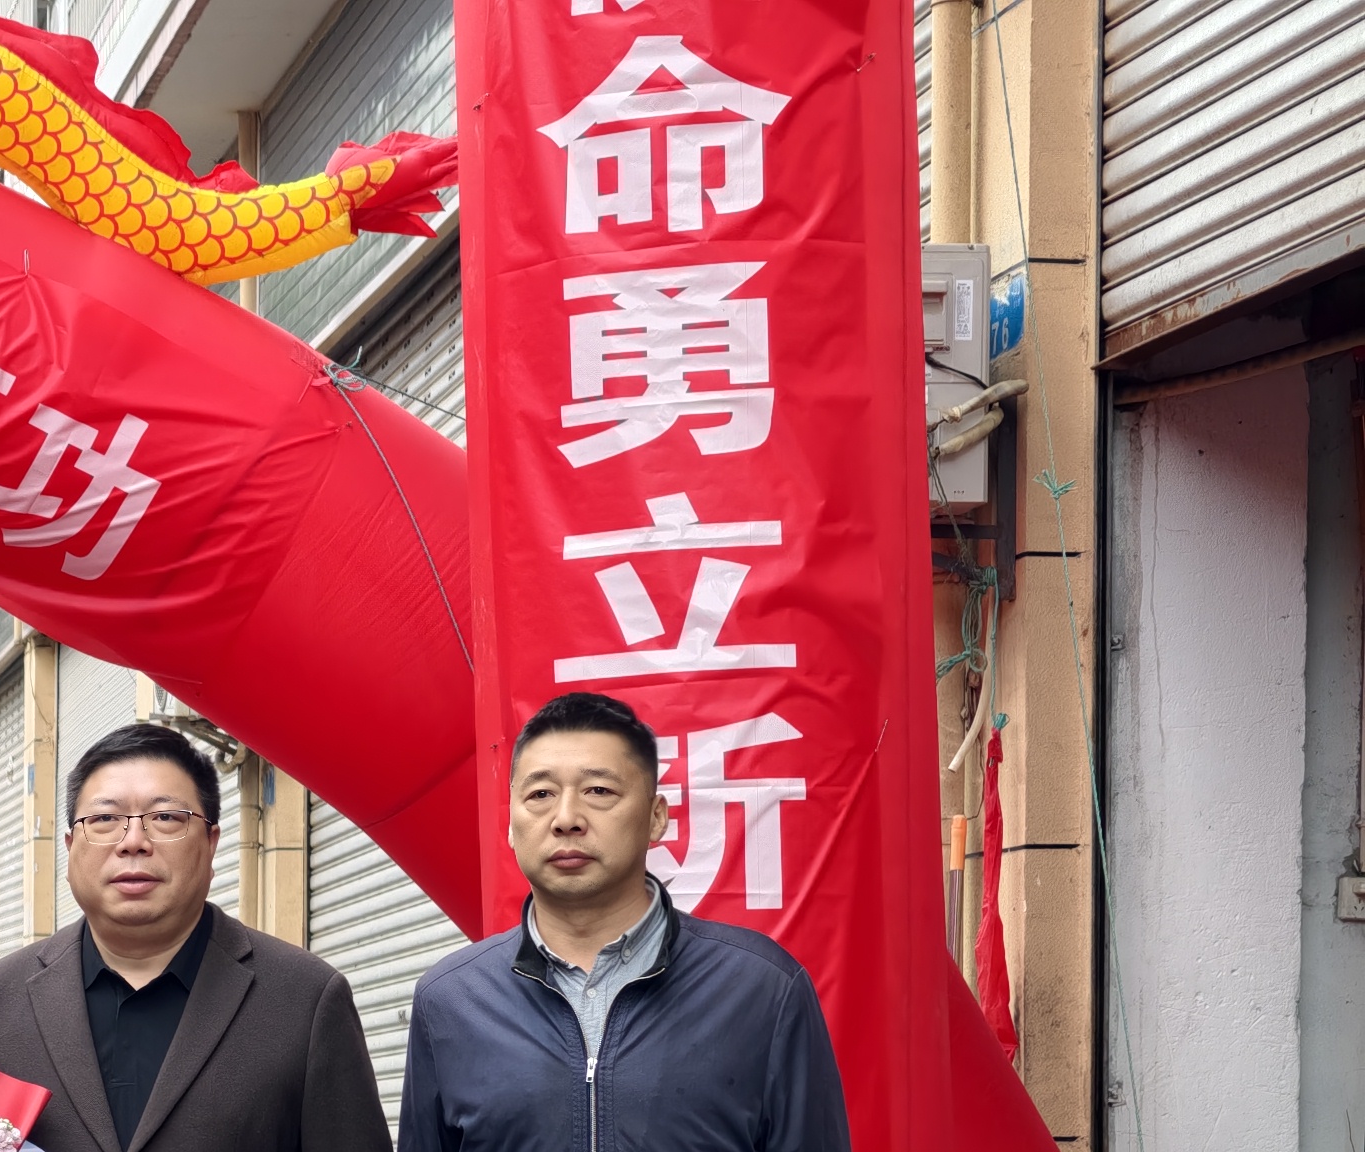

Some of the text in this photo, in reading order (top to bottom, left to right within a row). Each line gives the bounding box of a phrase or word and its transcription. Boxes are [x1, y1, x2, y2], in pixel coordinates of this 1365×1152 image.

[537, 0, 808, 911] 命勇立新
[991, 316, 1010, 355] 76
